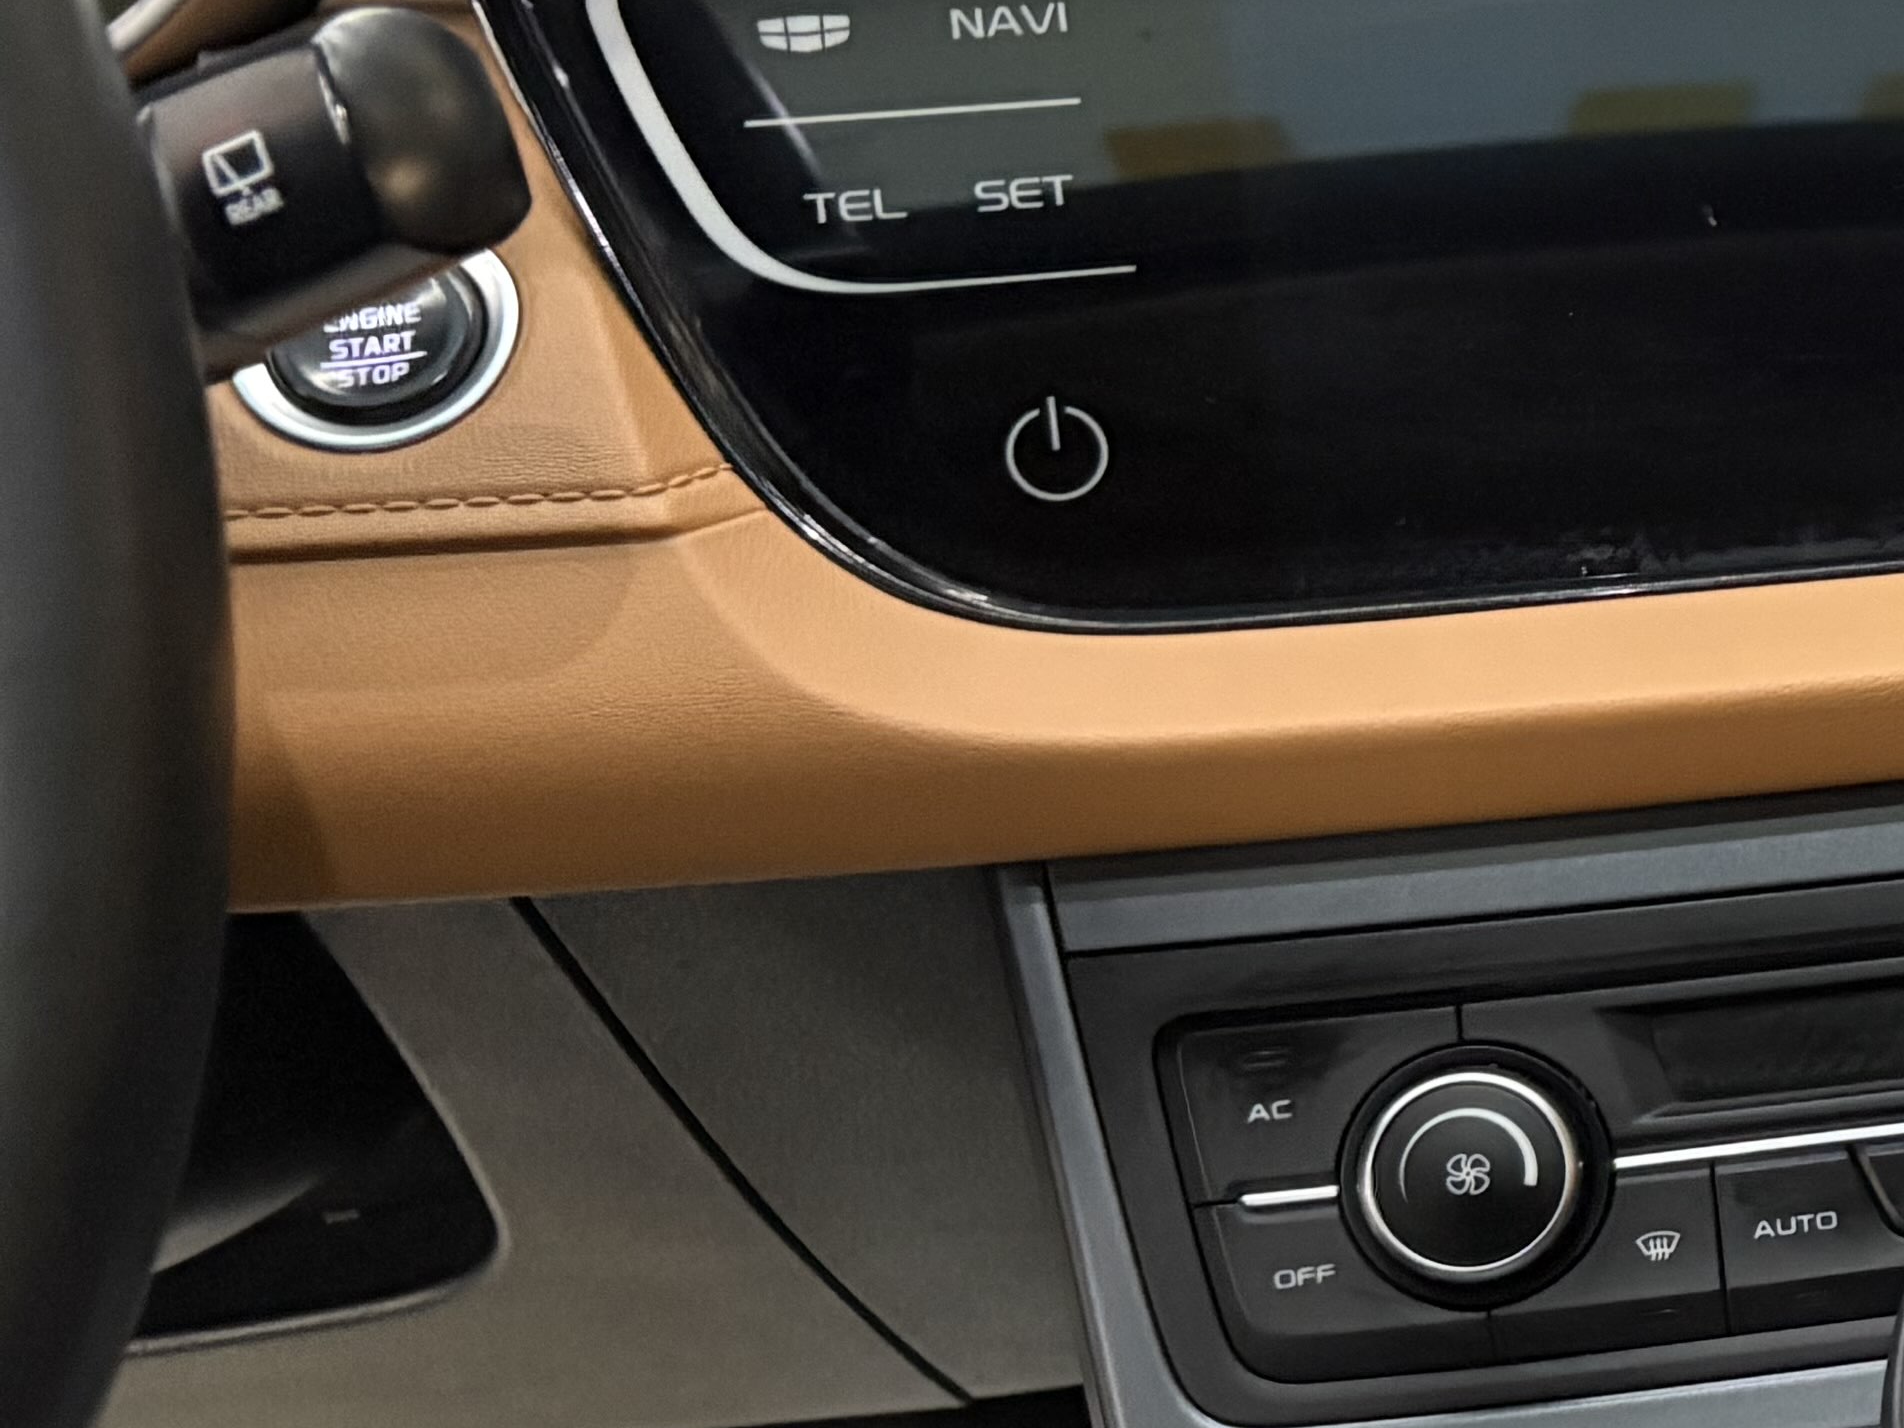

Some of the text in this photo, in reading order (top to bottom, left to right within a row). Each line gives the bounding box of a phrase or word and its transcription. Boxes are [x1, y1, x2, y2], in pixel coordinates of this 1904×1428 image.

[949, 1, 1068, 40] NAVI
[803, 188, 907, 224] TEL
[973, 174, 1073, 212] SET
[328, 330, 416, 361] START
[335, 362, 410, 388] STOP
[1247, 1099, 1292, 1123] AC
[1753, 1211, 1838, 1240] AUTO
[1273, 1263, 1336, 1290] OFF
